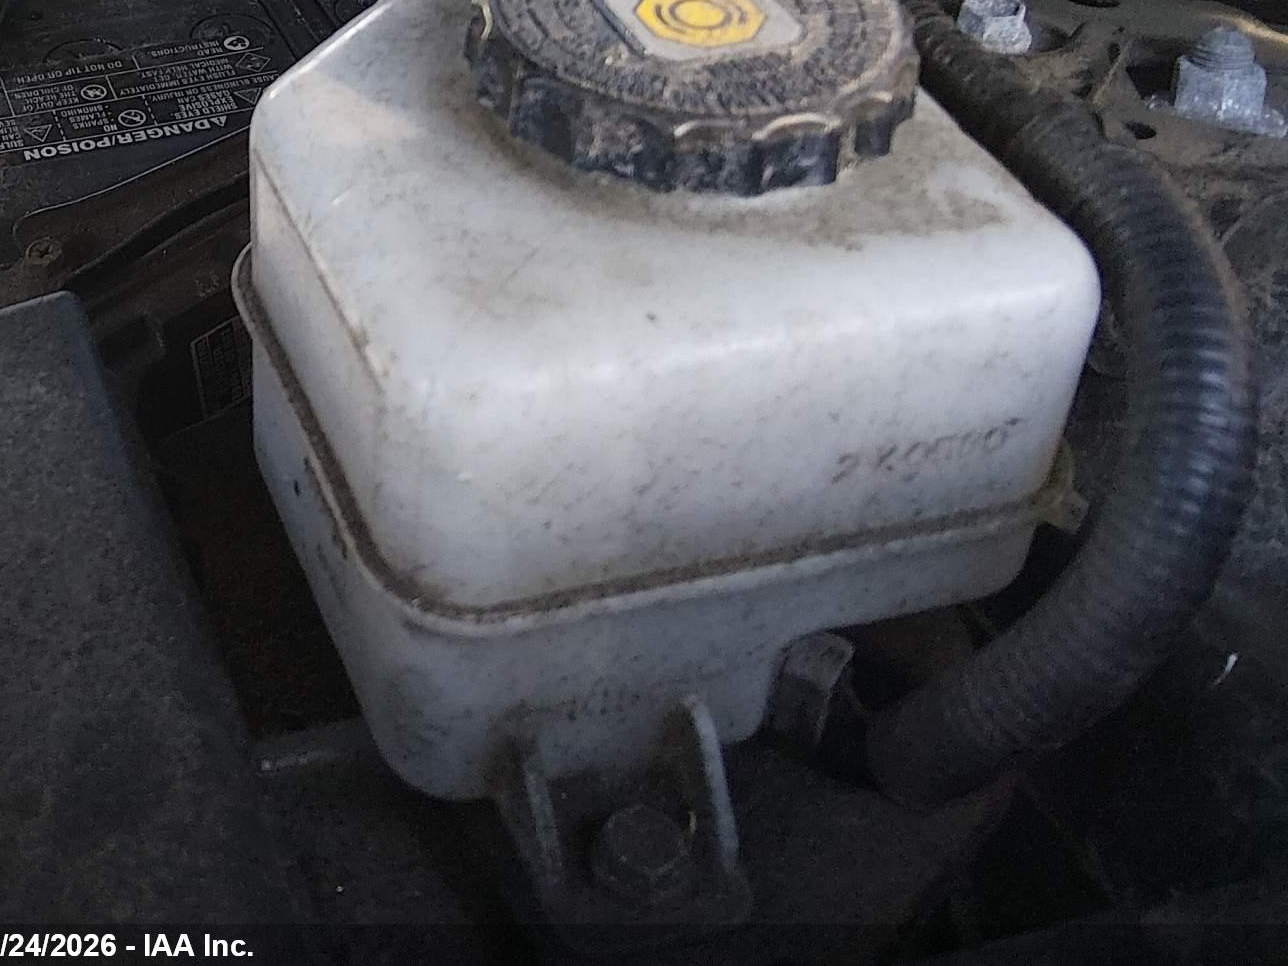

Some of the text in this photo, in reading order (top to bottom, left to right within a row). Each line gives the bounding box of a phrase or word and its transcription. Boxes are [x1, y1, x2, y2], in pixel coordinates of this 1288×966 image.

[65, 66, 82, 76] TIP
[84, 63, 106, 73] NOT
[107, 60, 123, 70] DO
[47, 70, 63, 79] OR
[207, 69, 236, 81] FLUSH
[119, 79, 180, 96] IMMEDIATELY
[200, 78, 251, 92] BLINDNESS
[56, 96, 80, 107] KEEP
[177, 89, 231, 104] GASES CAN
[178, 96, 235, 112] EXPLOSIVE
[201, 103, 238, 115] SHIELD
[103, 123, 118, 133] NO
[23, 119, 211, 161] DANGER/POISON
